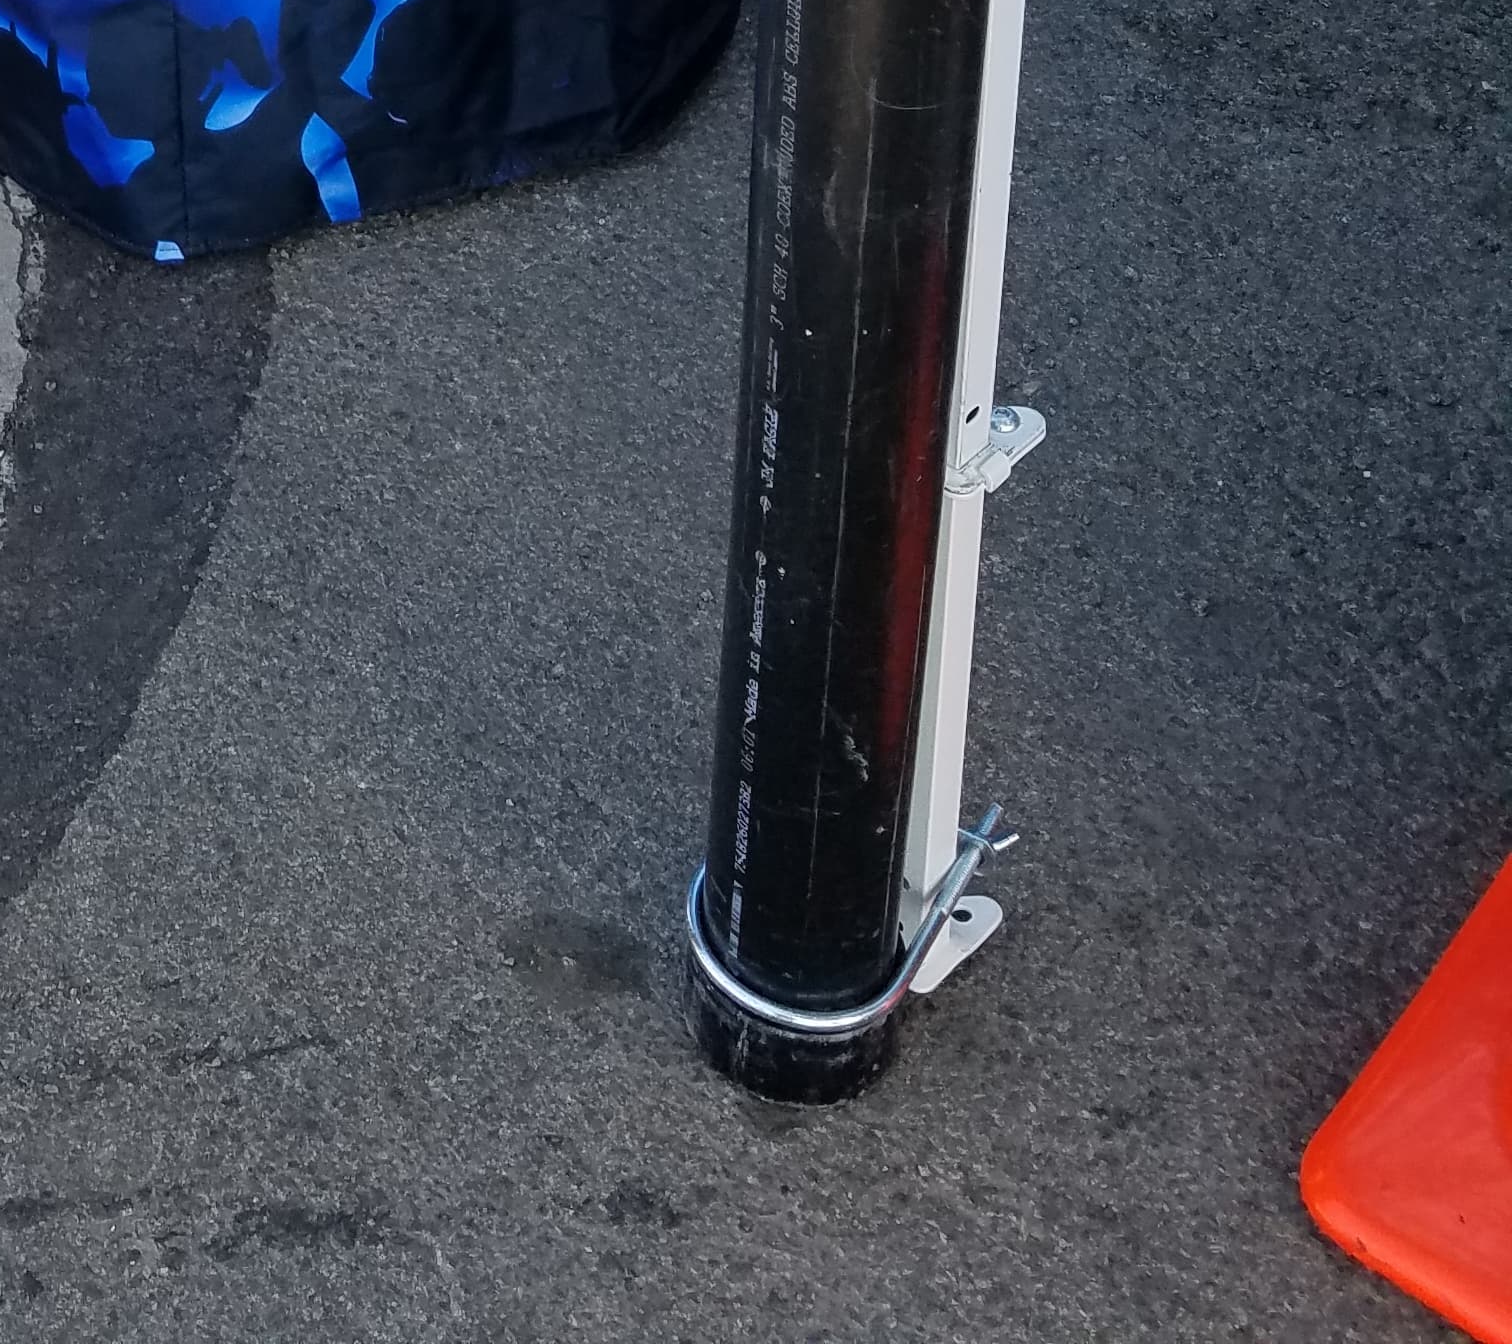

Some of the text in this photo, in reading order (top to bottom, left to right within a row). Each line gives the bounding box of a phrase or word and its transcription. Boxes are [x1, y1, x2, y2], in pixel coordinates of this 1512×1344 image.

[782, 72, 798, 111] ABS
[774, 234, 789, 258] 40
[772, 263, 788, 301] SCH
[744, 678, 759, 719] Made
